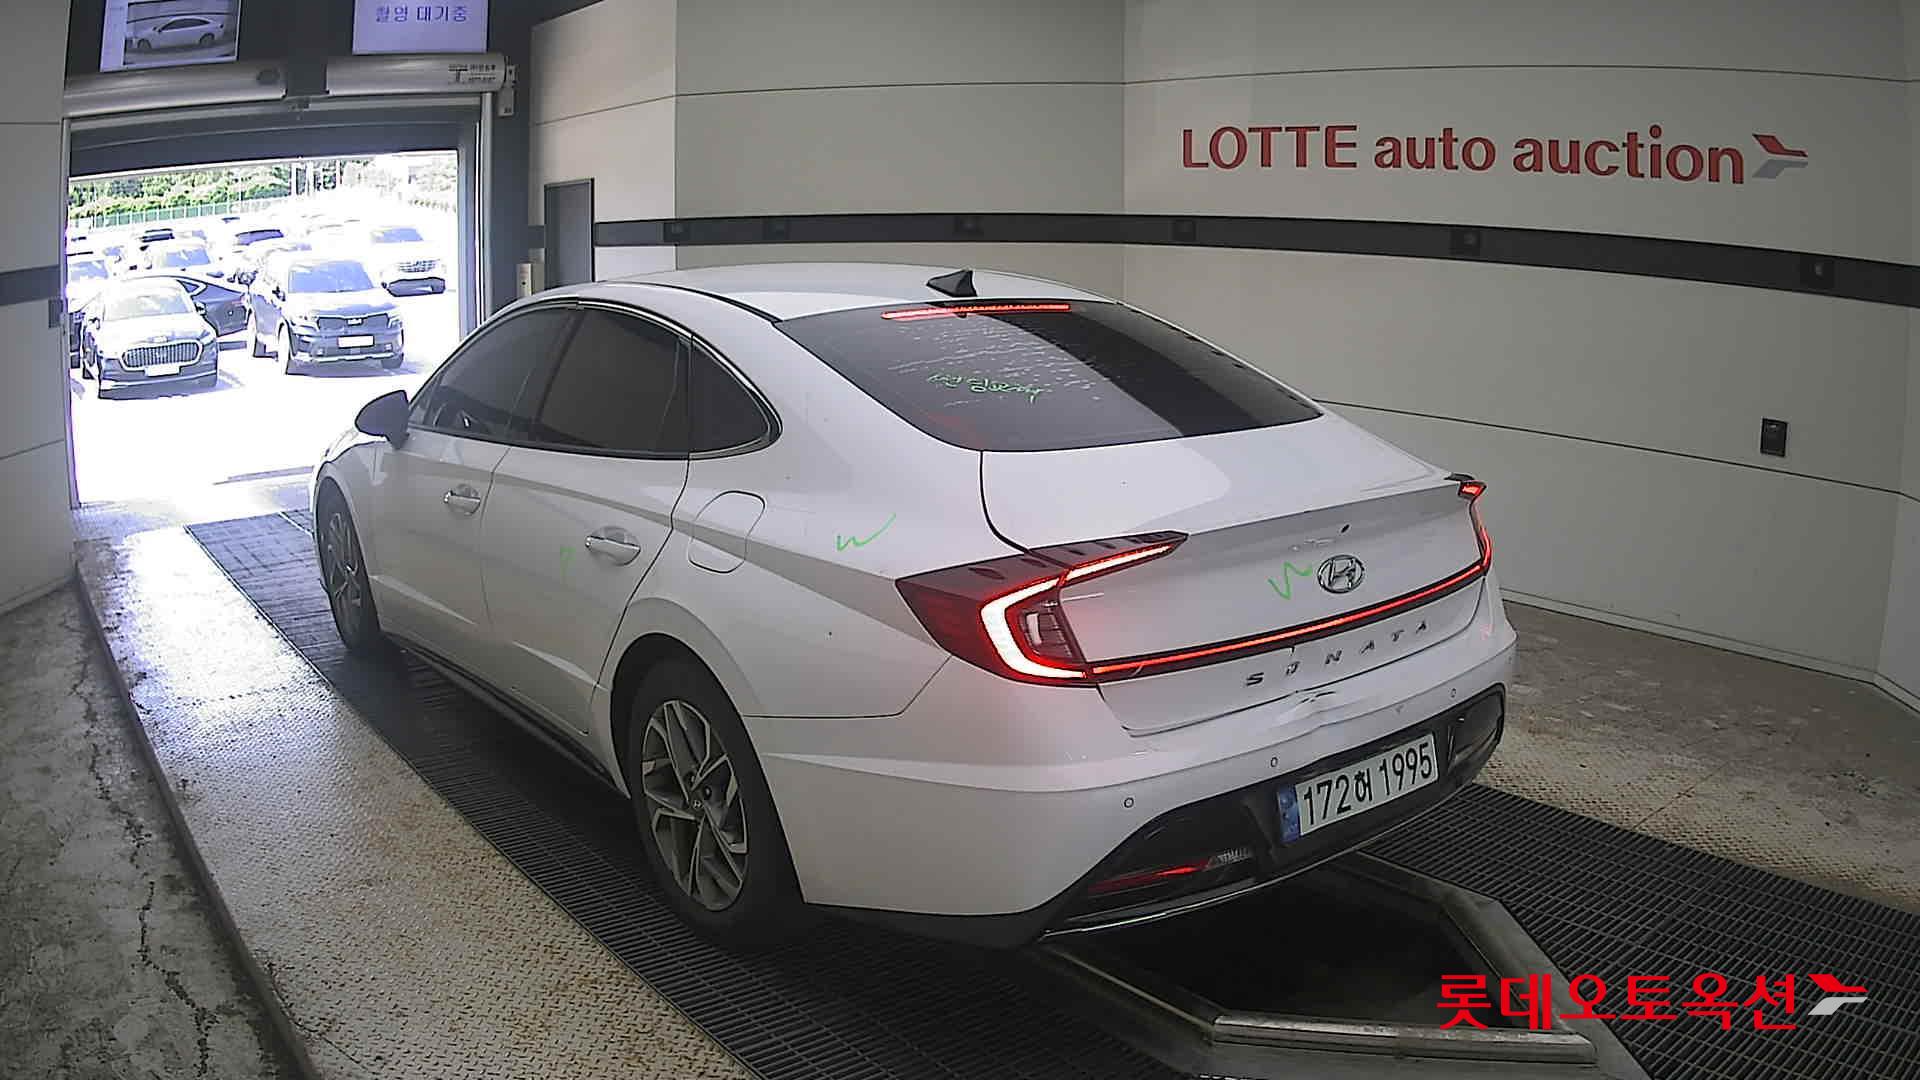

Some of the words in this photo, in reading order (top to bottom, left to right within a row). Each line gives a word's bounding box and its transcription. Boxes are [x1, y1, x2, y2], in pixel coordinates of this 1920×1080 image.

[416, 5, 467, 23] 대기중
[1183, 125, 1357, 169] LOTTE
[1374, 127, 1496, 171] auto
[1512, 124, 1744, 184] auction
[1303, 768, 1373, 826] 172허
[1379, 741, 1433, 796] 1995
